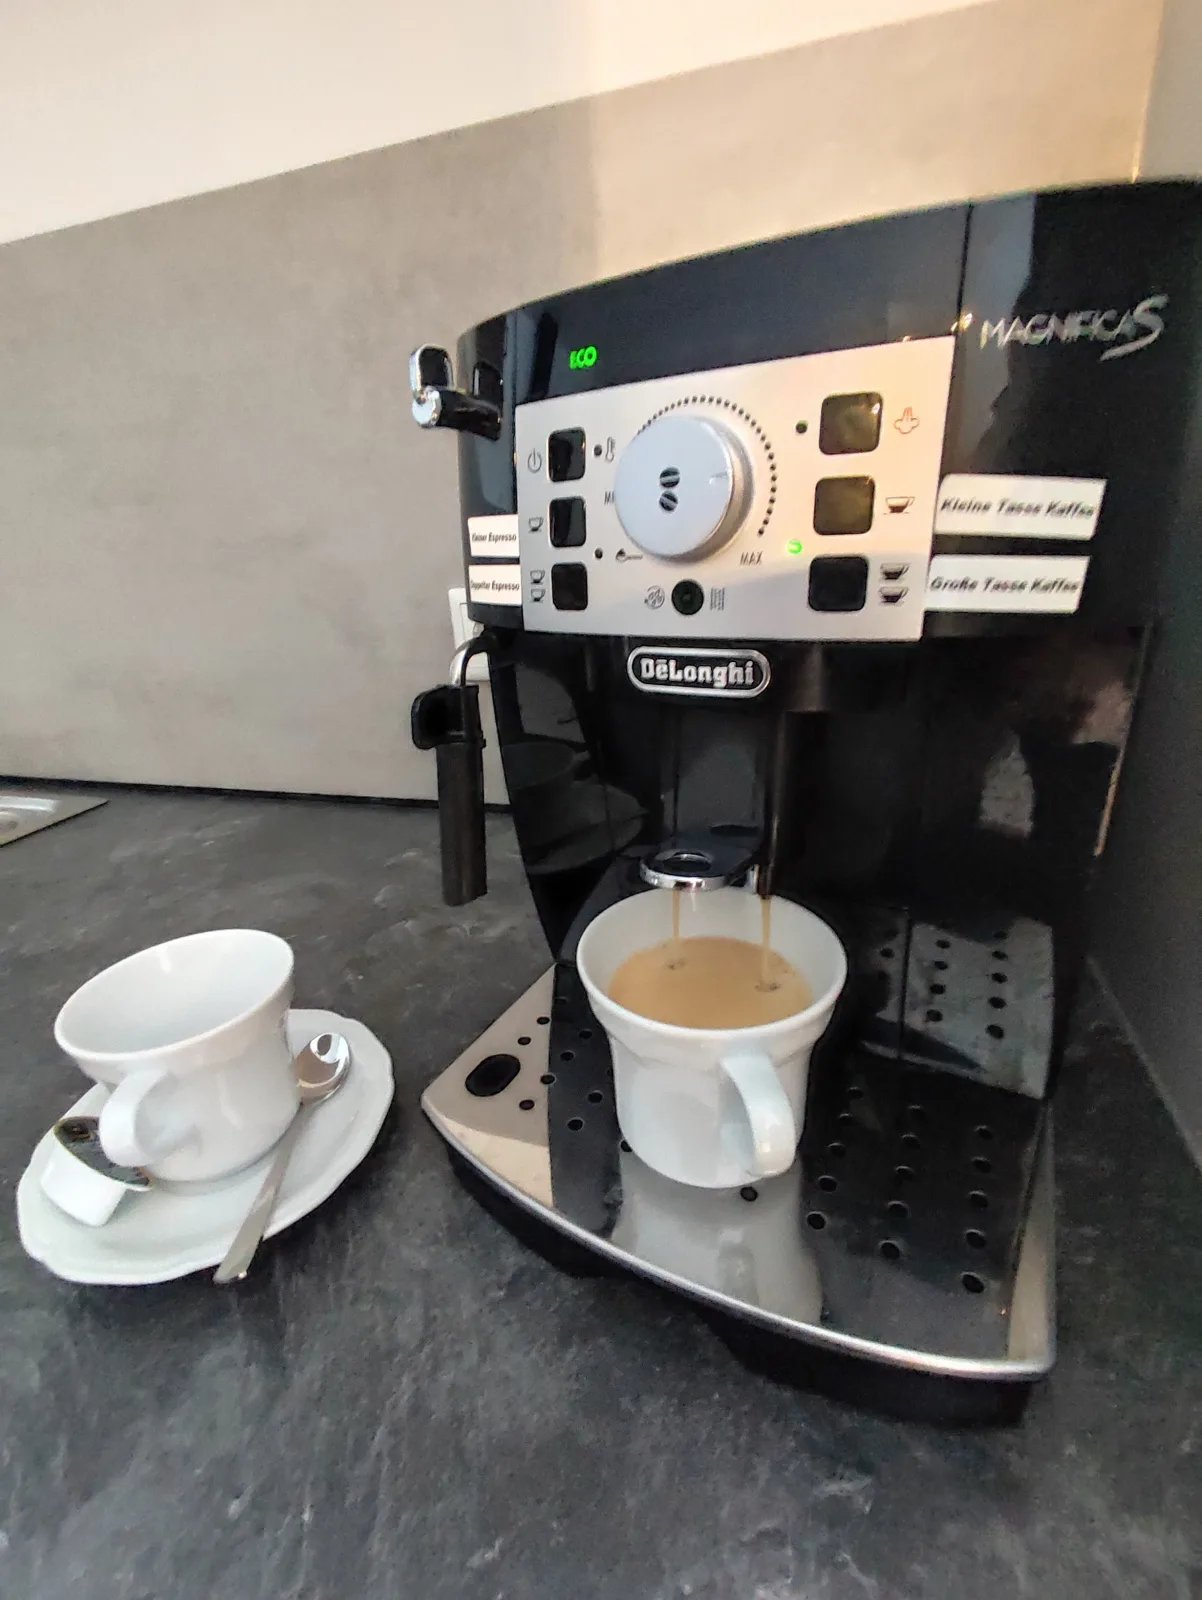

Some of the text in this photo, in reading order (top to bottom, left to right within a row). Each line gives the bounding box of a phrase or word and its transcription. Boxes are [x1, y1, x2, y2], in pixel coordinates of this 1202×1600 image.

[569, 346, 597, 369] ECO
[604, 490, 615, 505] MI
[941, 498, 1094, 518] Kleine Tasse Kaffee
[489, 532, 517, 543] Espresso
[740, 551, 763, 566] MAX
[491, 580, 520, 592] Espresso
[930, 577, 1080, 593] Große Tasse Kaffee
